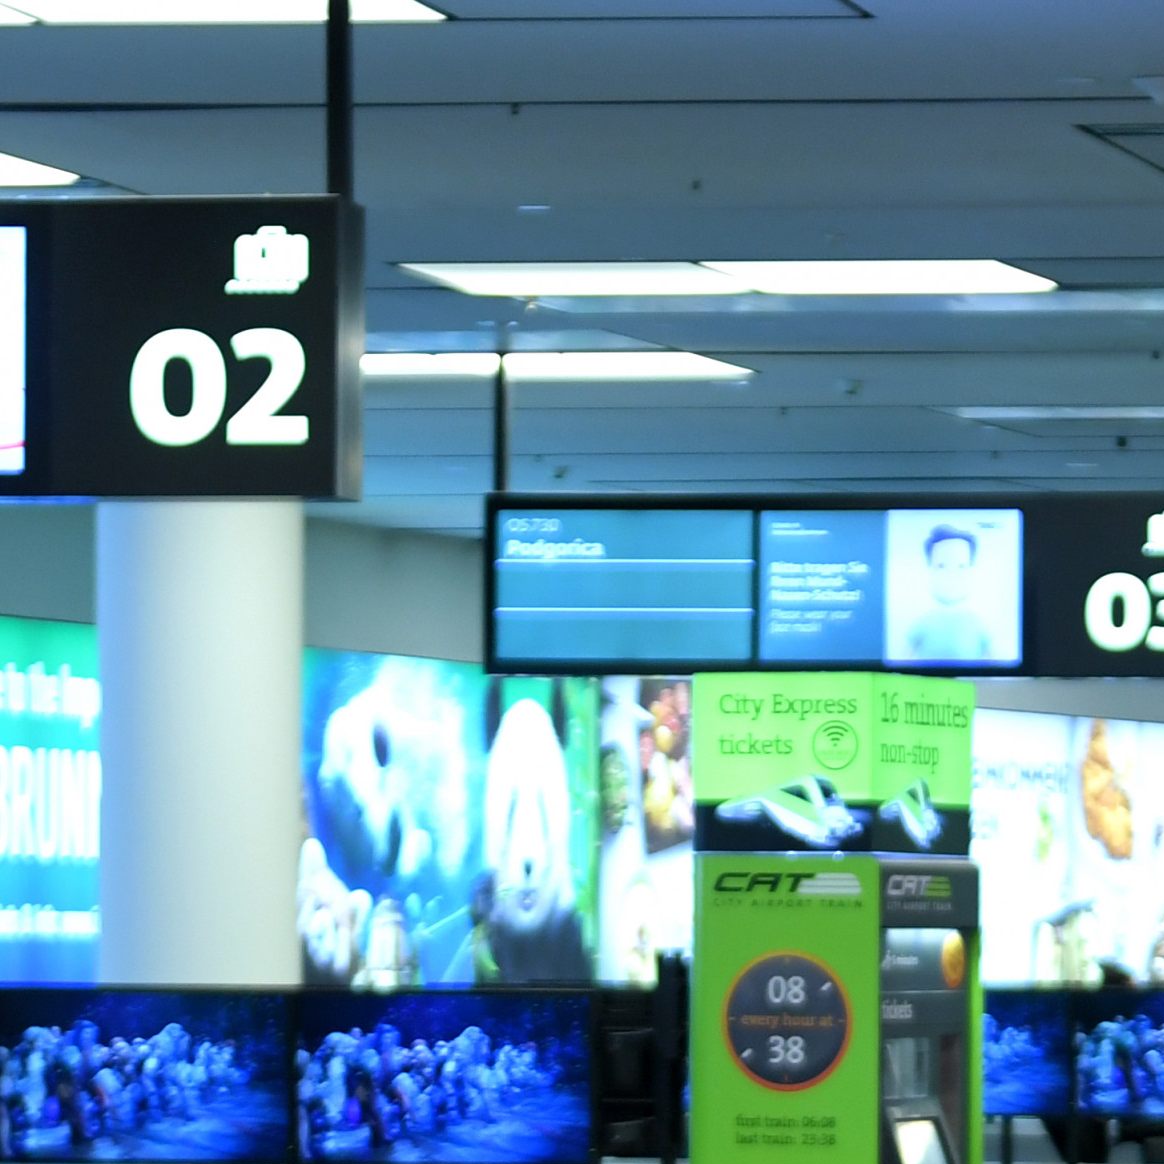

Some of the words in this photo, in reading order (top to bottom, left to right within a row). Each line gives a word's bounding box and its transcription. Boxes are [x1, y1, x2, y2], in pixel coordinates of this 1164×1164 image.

[130, 327, 310, 447] 02
[507, 538, 604, 559] Podgorica
[719, 693, 765, 721] City
[771, 693, 858, 721] Express
[880, 691, 900, 723] 16
[904, 693, 969, 729] minutes
[718, 733, 794, 755] tickets
[880, 739, 940, 774] non-stop
[714, 872, 815, 893] CAT
[887, 875, 932, 896] CAT
[714, 897, 742, 908] CITY
[751, 898, 812, 909] AIRPORT
[819, 899, 864, 909] TRAIN
[767, 975, 806, 1004] 08
[741, 1014, 779, 1028] every
[783, 1012, 816, 1026] hour
[819, 1014, 833, 1027] at
[768, 1035, 805, 1064] 38
[735, 1114, 762, 1127] first
[735, 1132, 758, 1145] last
